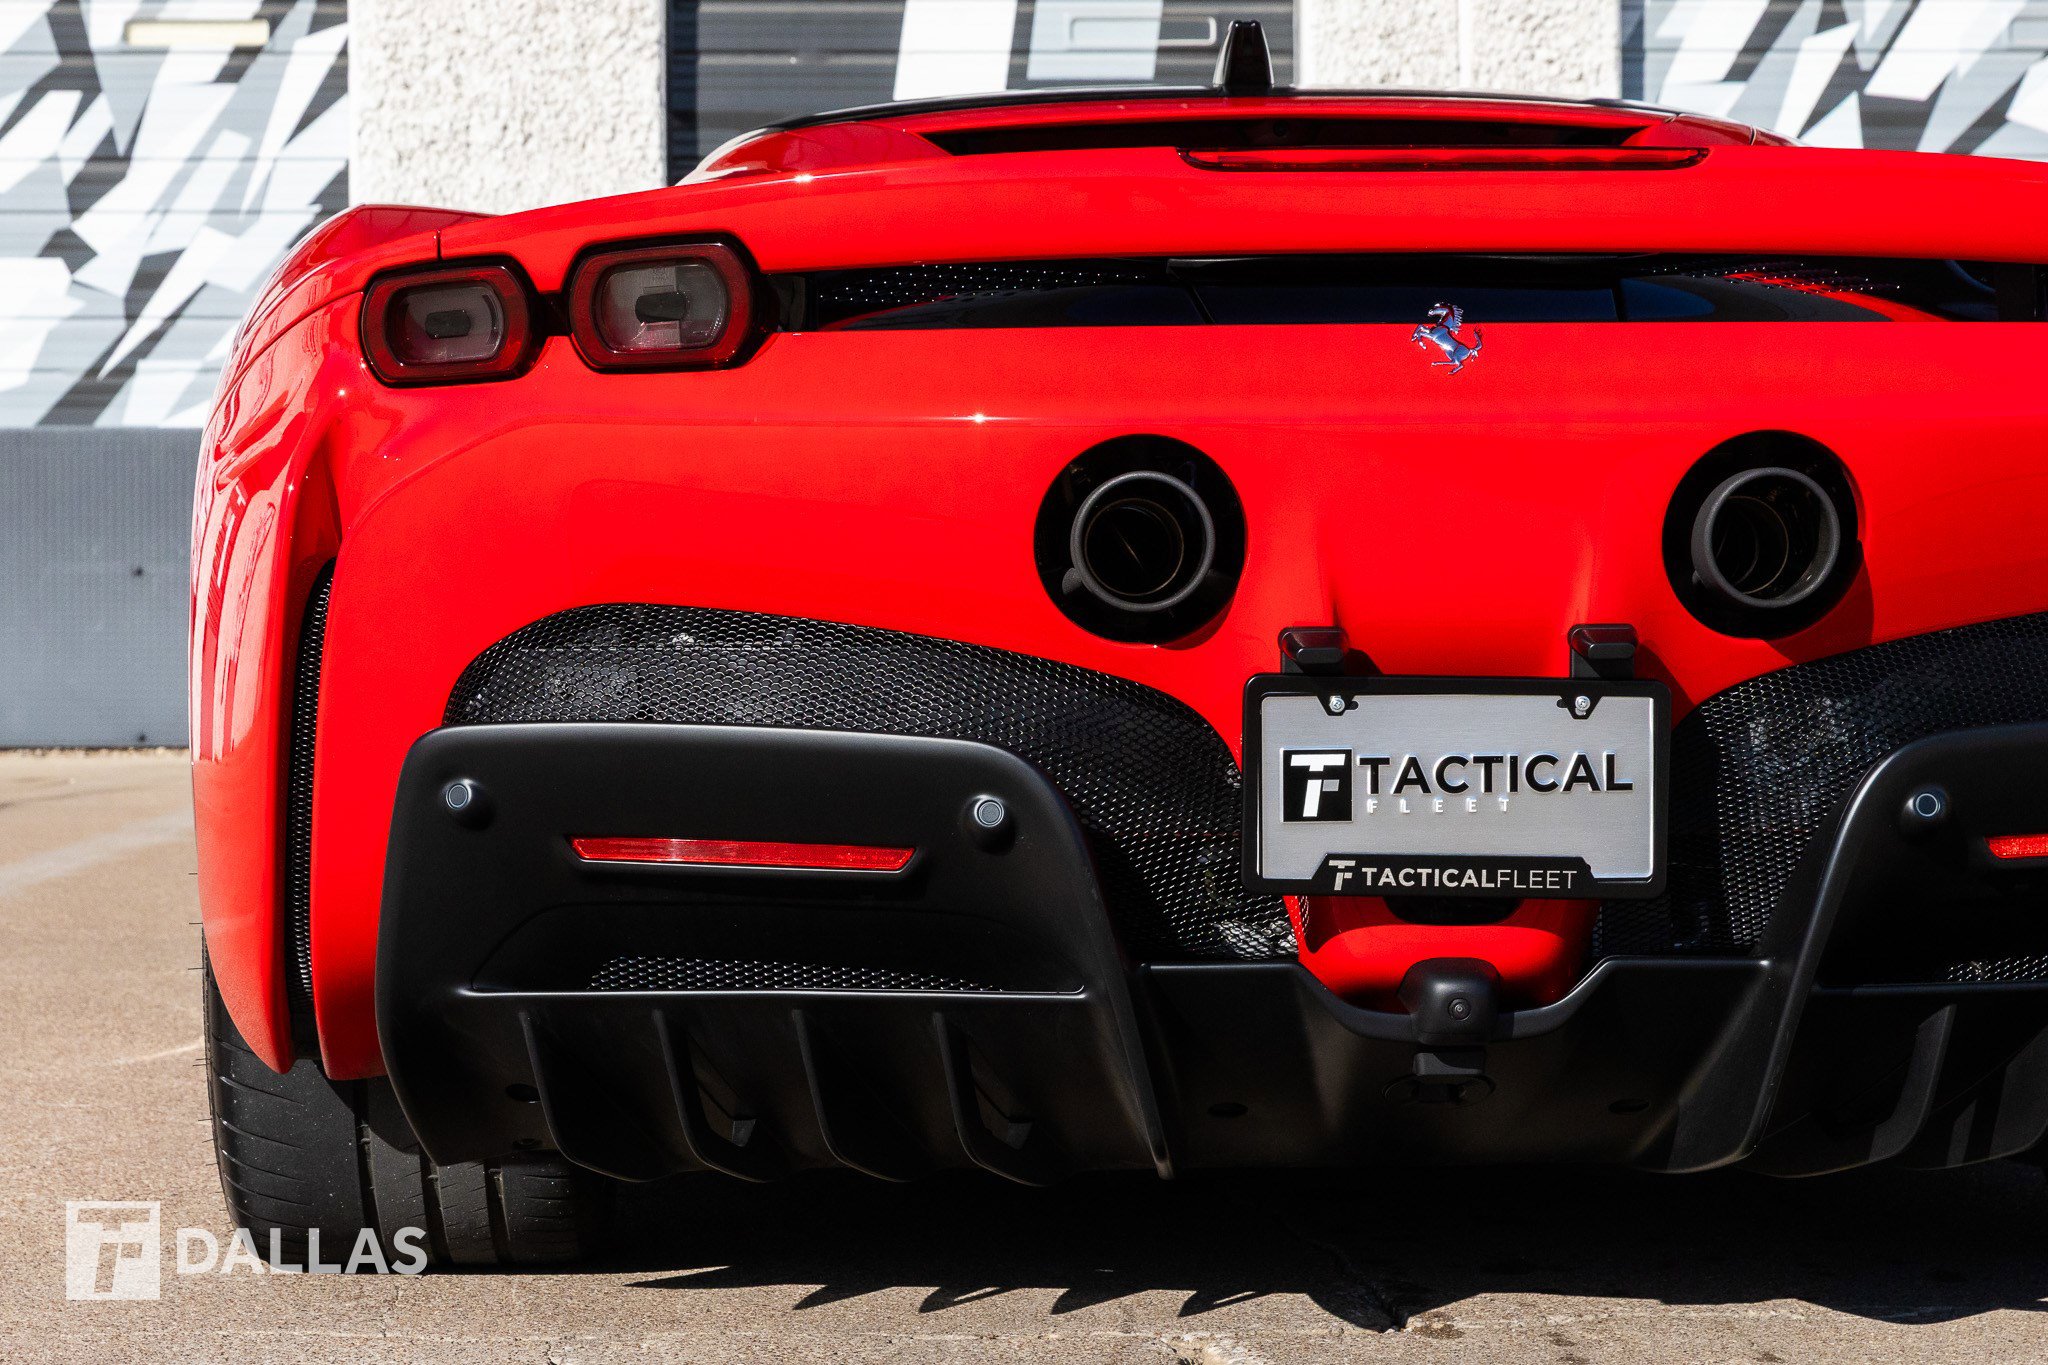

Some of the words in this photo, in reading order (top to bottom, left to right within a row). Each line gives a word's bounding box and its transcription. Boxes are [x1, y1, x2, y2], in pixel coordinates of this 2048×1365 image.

[1357, 750, 1634, 795] TACTICAL
[1366, 798, 1511, 815] FLEET
[1361, 867, 1578, 889] TACTICALFLEET
